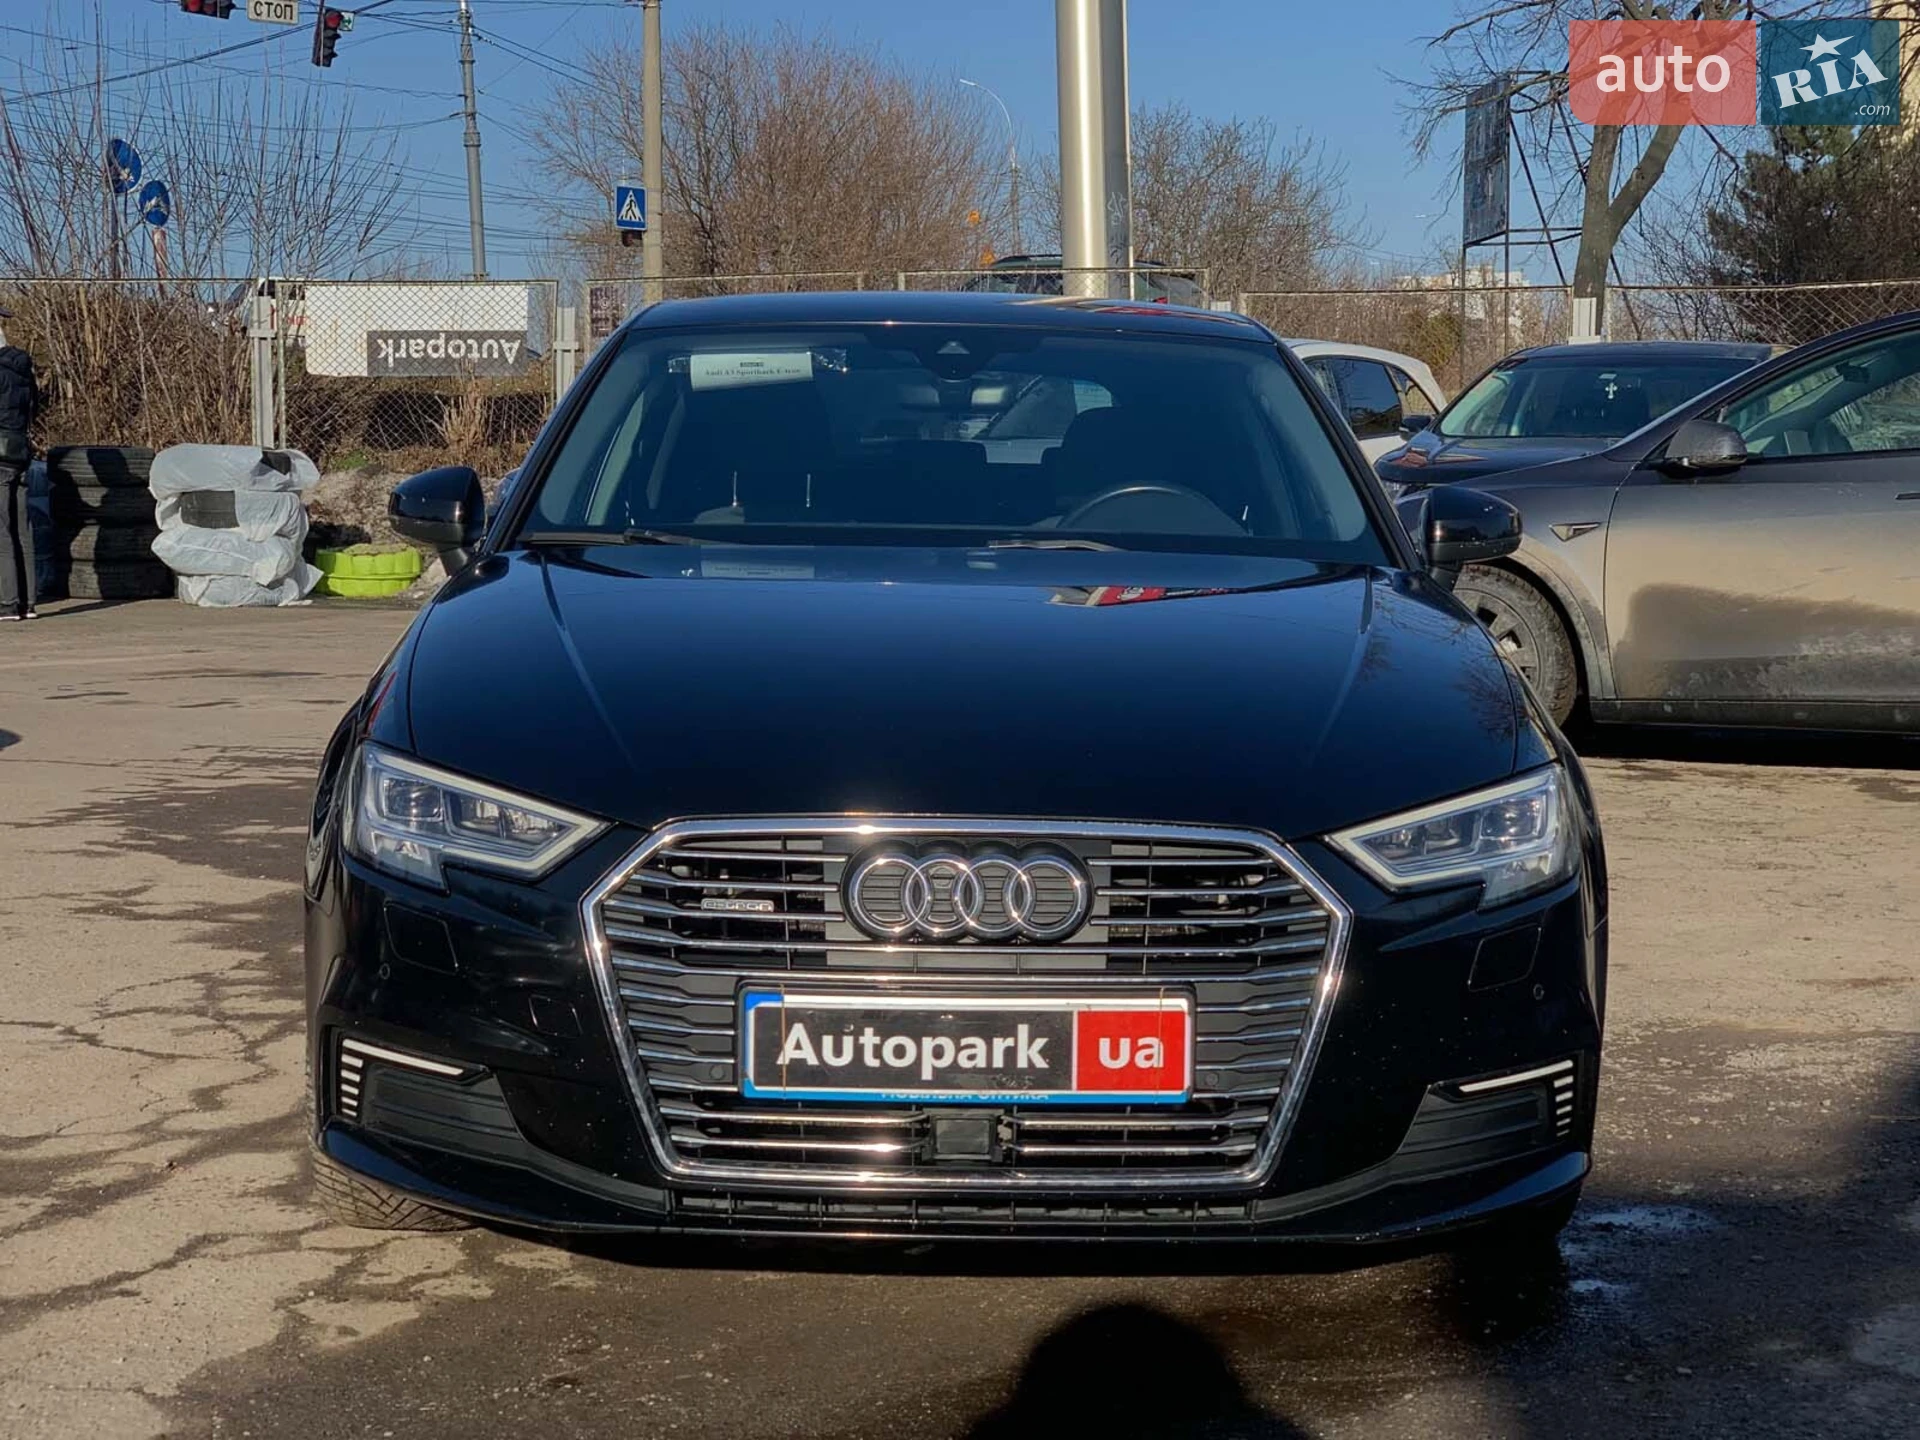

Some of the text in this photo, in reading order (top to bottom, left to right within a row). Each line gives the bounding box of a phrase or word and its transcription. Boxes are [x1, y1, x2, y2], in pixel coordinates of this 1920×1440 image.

[253, 1, 294, 20] СТОП
[376, 333, 521, 367] Autopark
[776, 1023, 1165, 1081] Autopark ua
